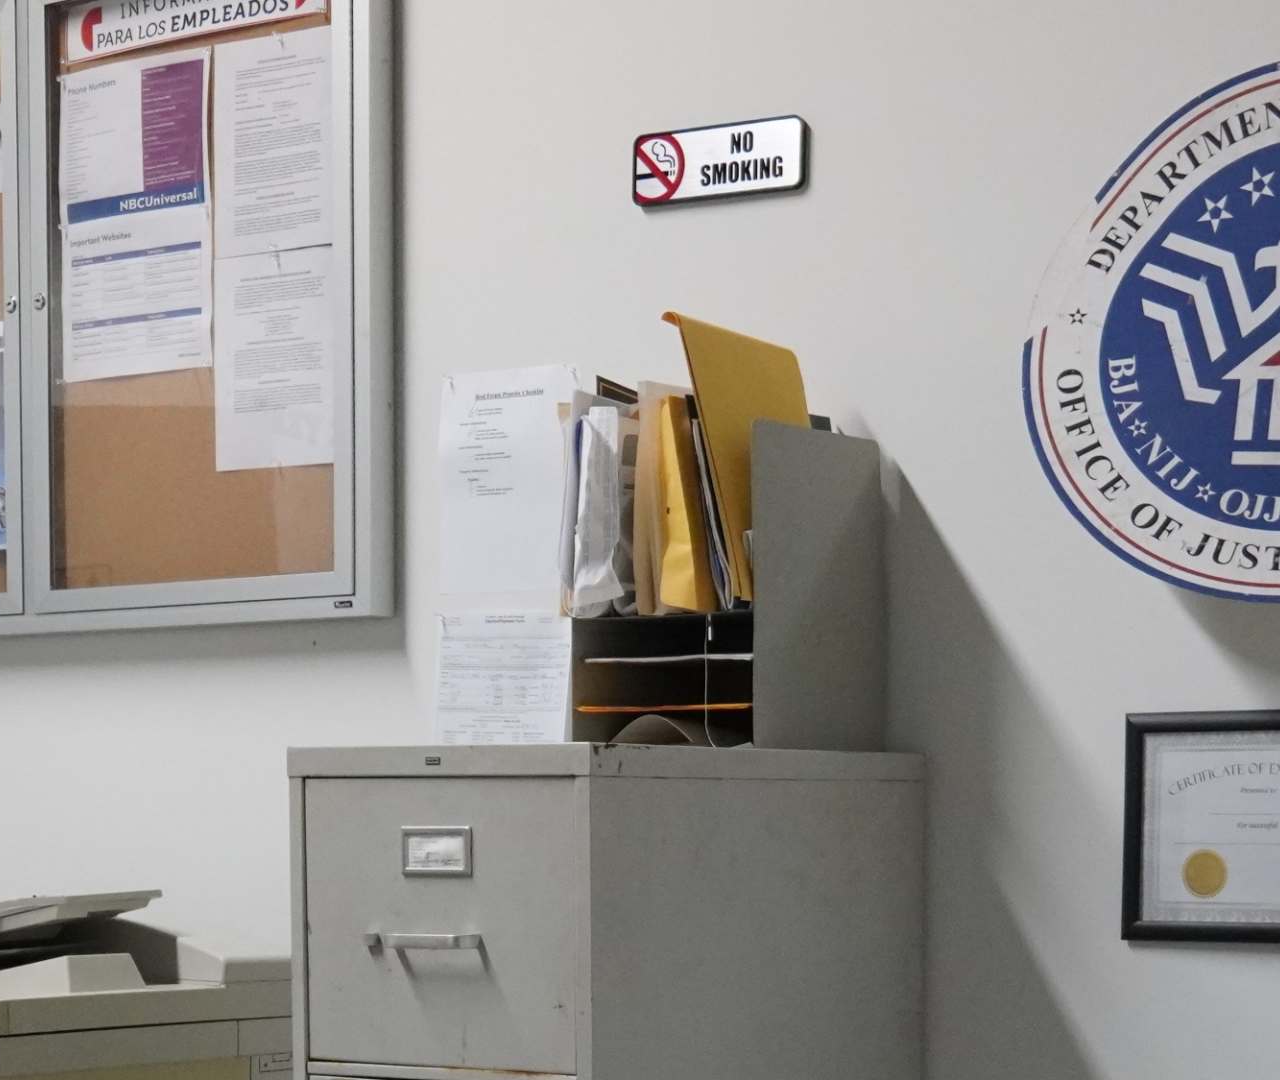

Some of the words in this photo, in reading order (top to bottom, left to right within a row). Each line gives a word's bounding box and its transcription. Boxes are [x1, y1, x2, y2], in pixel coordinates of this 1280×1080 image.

[97, 28, 133, 48] PARA
[138, 20, 166, 40] LOS
[170, 0, 289, 33] EMPLEADOS
[729, 130, 754, 154] NO
[700, 155, 783, 187] SMOKING
[119, 187, 198, 213] NBCUniversal
[1107, 355, 1144, 424] BJA
[1133, 435, 1199, 493] NIJ
[1056, 367, 1130, 502] OFFICE
[1130, 501, 1182, 543] OF
[1167, 763, 1244, 797] CERTIFICATE
[1247, 761, 1264, 775] OF
